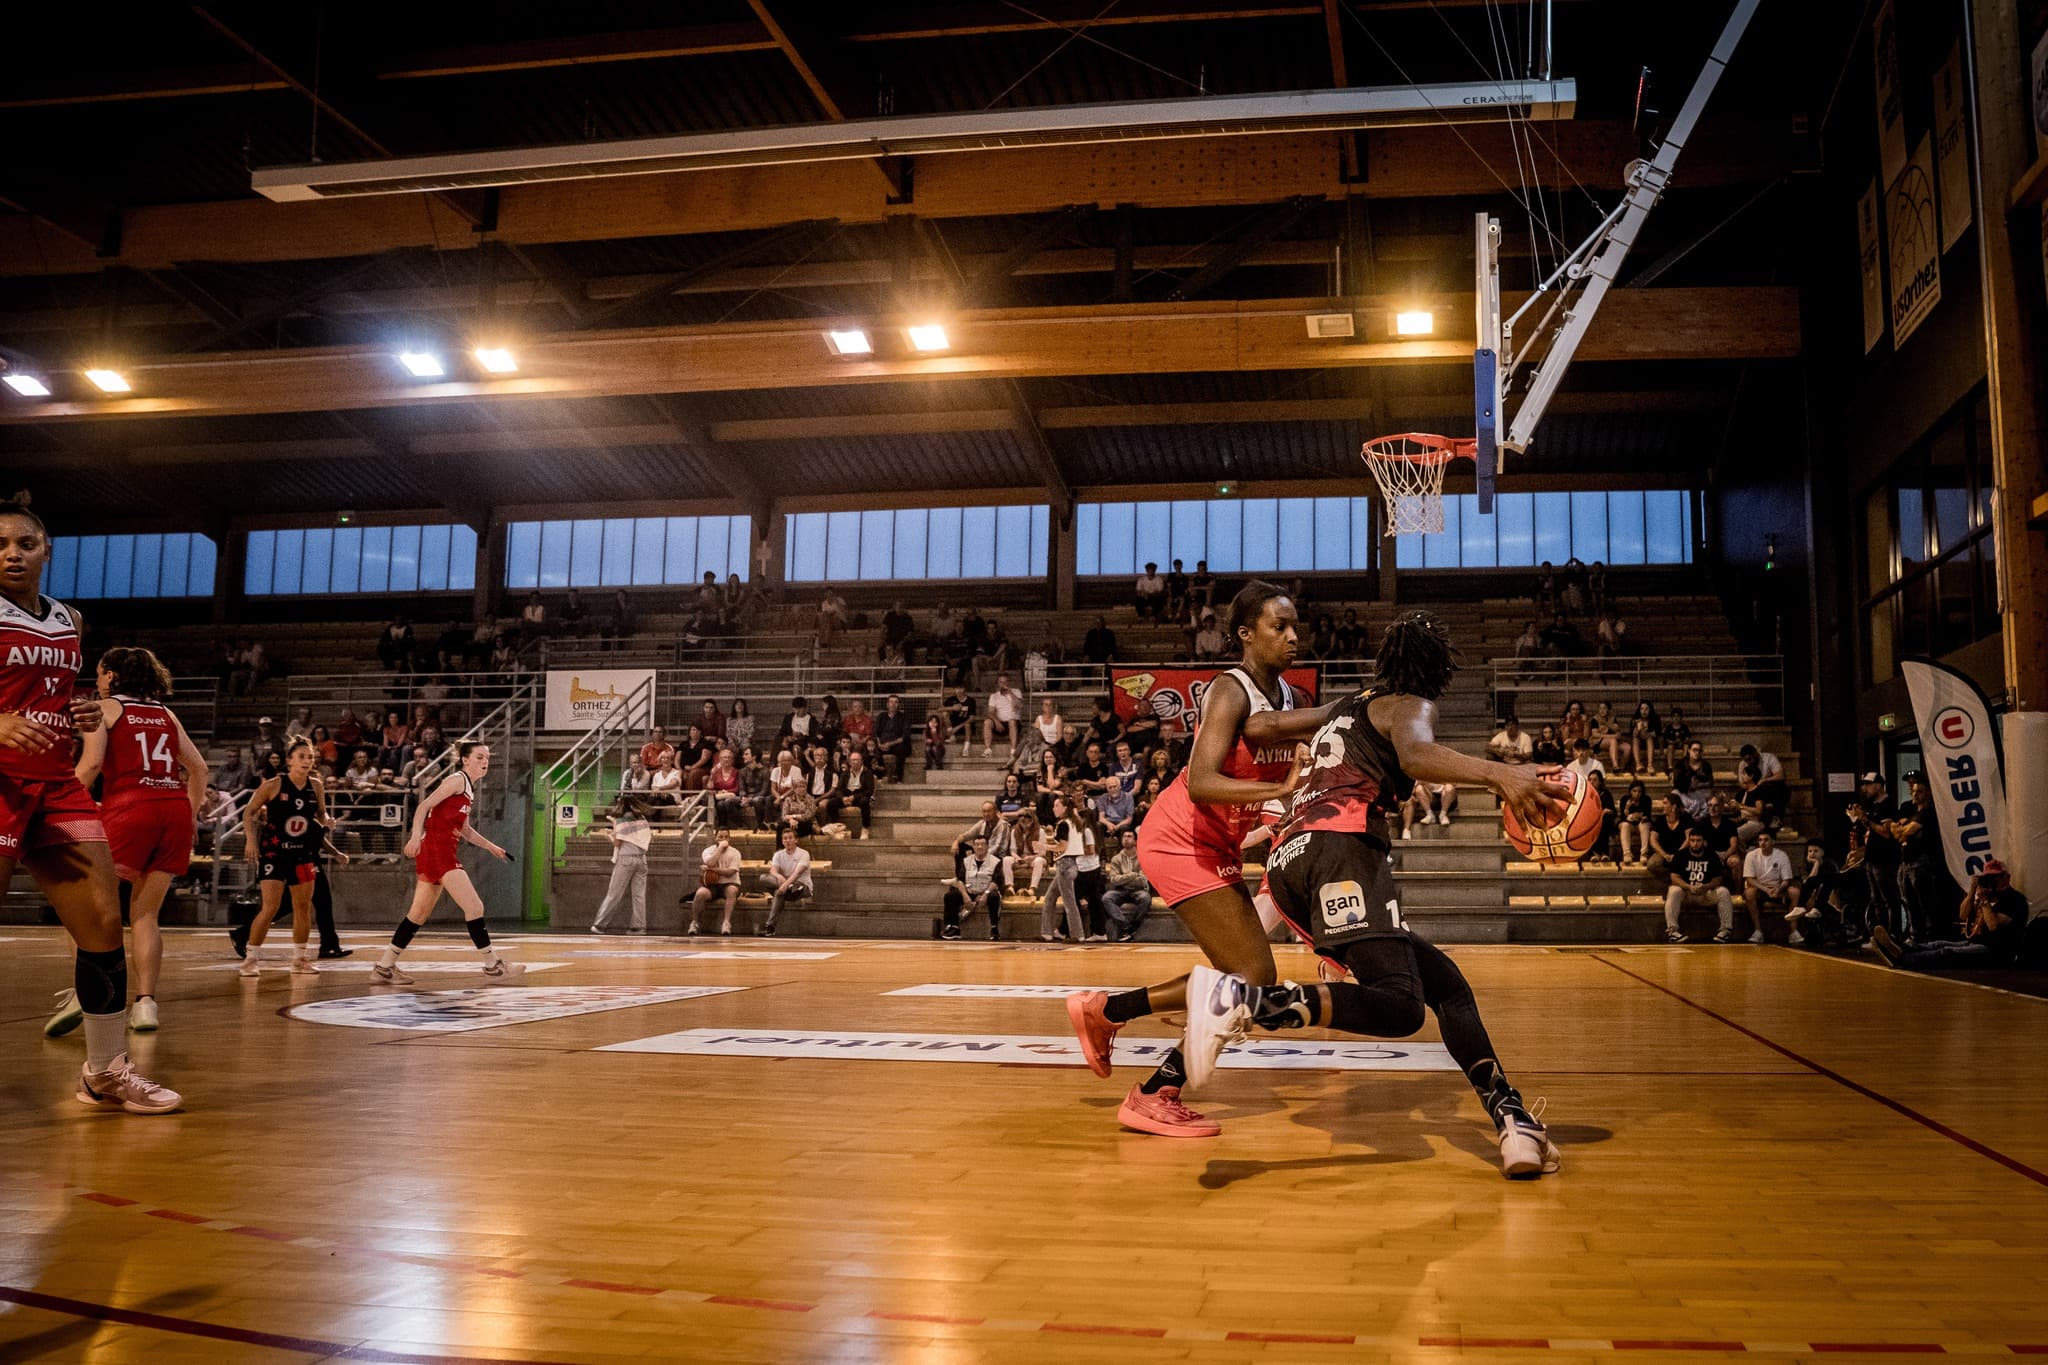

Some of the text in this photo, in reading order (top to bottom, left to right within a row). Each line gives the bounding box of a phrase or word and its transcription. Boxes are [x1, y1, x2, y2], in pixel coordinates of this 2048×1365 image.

[1463, 96, 1497, 105] CERA
[573, 701, 611, 710] ORTHEZ
[127, 714, 167, 726] Bouvet
[135, 731, 174, 773] 14
[295, 798, 304, 810] 9
[264, 863, 274, 875] 9
[1685, 860, 1709, 872] JUST
[1689, 871, 1704, 882] DO
[1326, 895, 1360, 916] gan
[703, 1036, 1005, 1051] Mutuel
